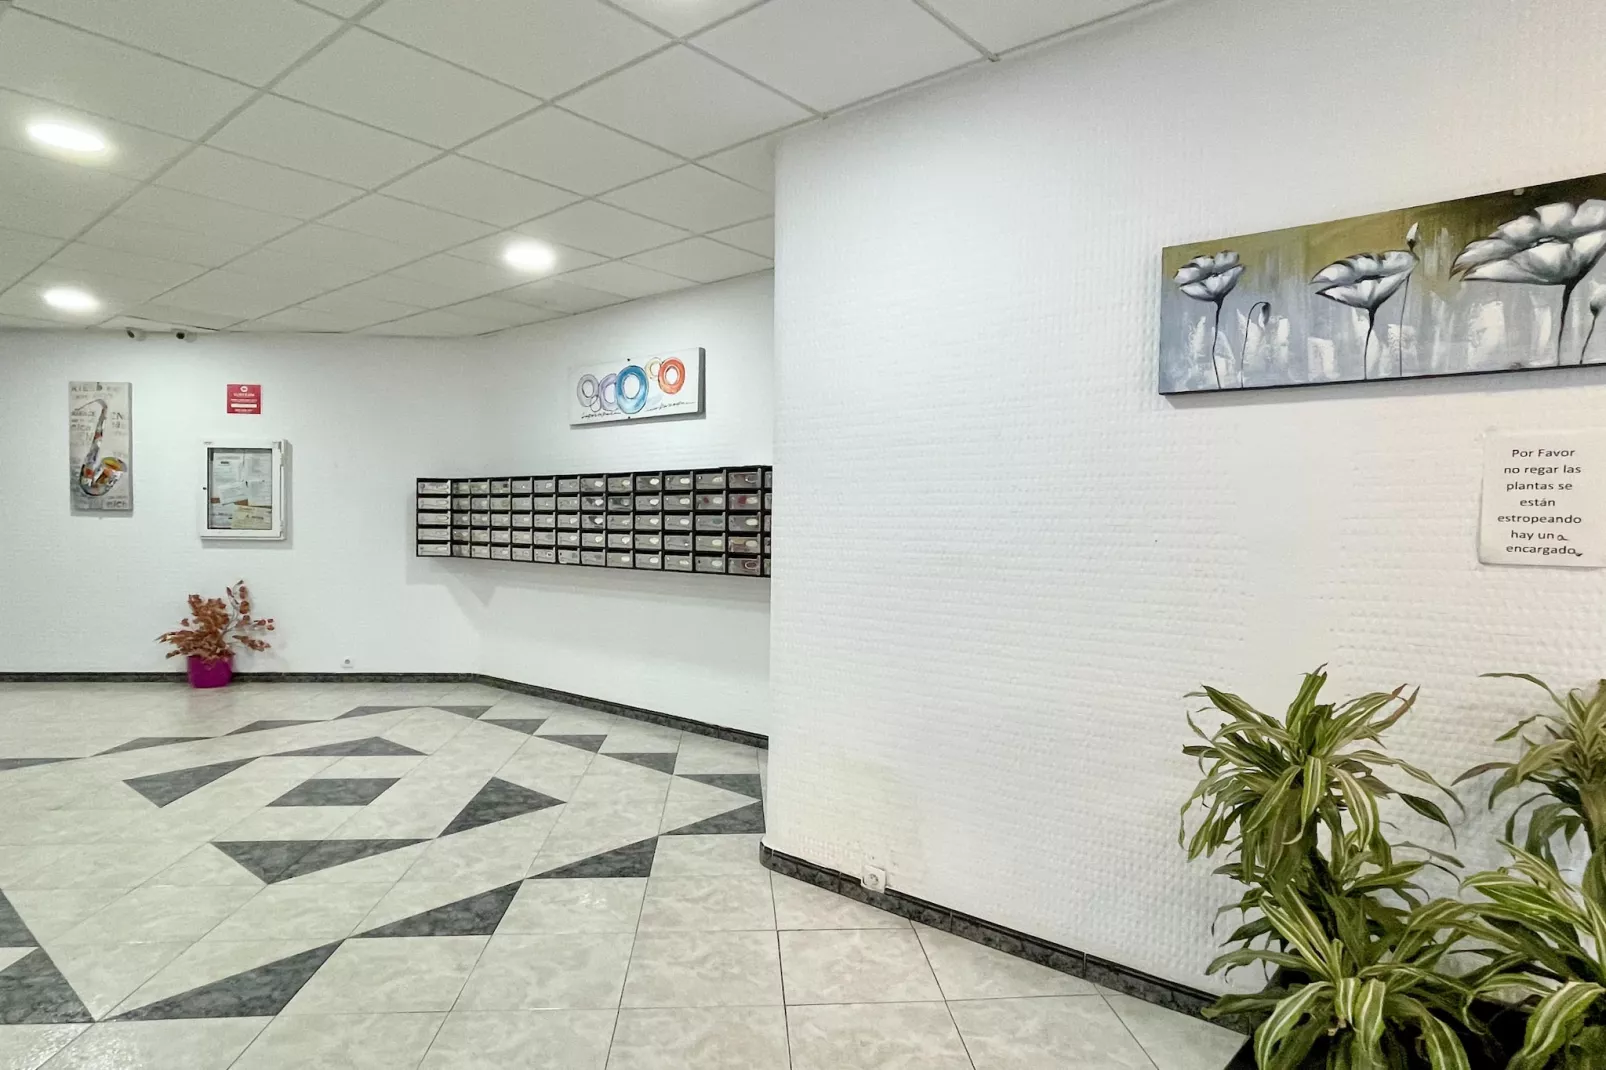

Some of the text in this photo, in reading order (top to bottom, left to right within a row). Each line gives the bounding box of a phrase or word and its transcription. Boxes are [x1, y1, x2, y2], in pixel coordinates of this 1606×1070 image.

[1524, 466, 1558, 475] regar
[1564, 465, 1581, 473] las
[1506, 482, 1554, 491] plantas
[1520, 498, 1556, 506] están
[1498, 515, 1581, 524] estropeando
[1511, 530, 1534, 540] hay
